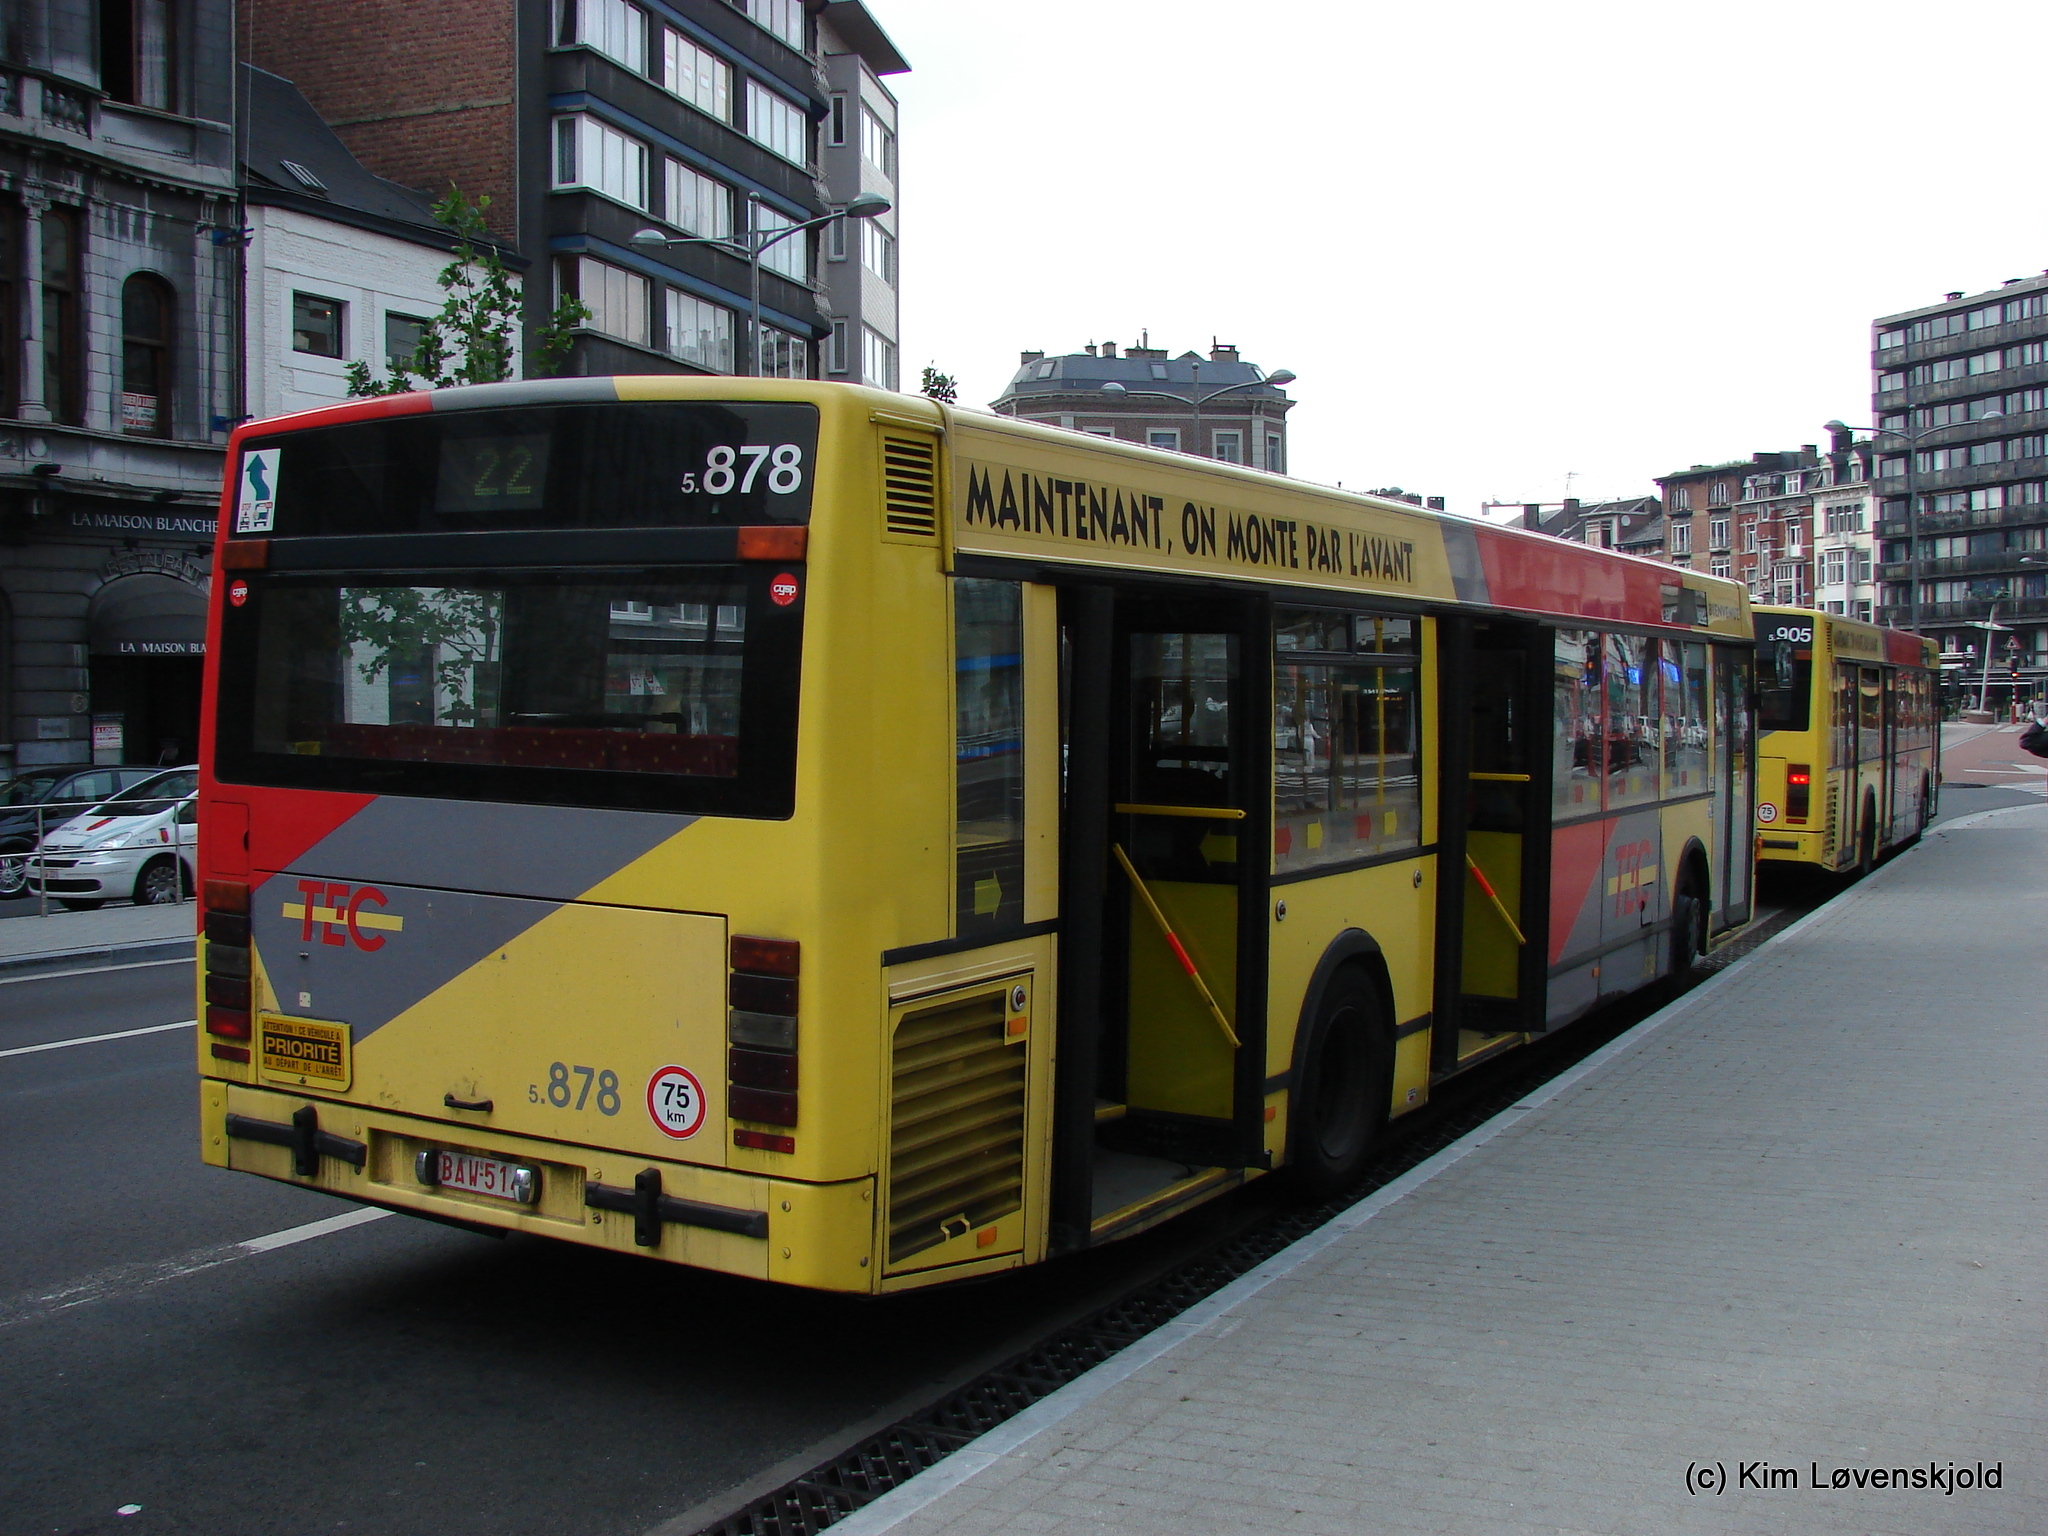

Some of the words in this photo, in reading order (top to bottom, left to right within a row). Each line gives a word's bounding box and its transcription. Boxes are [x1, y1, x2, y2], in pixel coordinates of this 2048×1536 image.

[475, 447, 531, 496] 22
[681, 443, 802, 495] 5.878
[72, 513, 91, 526] LA
[95, 514, 153, 530] MAISON
[157, 517, 219, 533] BLANCHE
[966, 463, 1172, 555] MAINTENANT,
[1182, 502, 1216, 557] ON
[1227, 511, 1299, 569] MONTE
[1306, 524, 1342, 574] PAR
[1349, 532, 1412, 583] L'AVANT
[106, 553, 202, 579] RESTAURANT
[120, 642, 136, 653] LA
[142, 643, 186, 653] MAISON
[190, 643, 207, 653] BLA
[1761, 807, 1772, 815] 75
[1615, 839, 1653, 919] TEC
[298, 879, 388, 952] TEC
[263, 1021, 294, 1034] ATTENTION
[265, 1036, 338, 1063] PRIORITÉ
[263, 1056, 272, 1065] AU
[303, 1062, 312, 1072] DE
[528, 1061, 621, 1116] 5.878
[661, 1082, 690, 1109] 75
[666, 1109, 685, 1123] km
[441, 1154, 515, 1192] BAW-51
